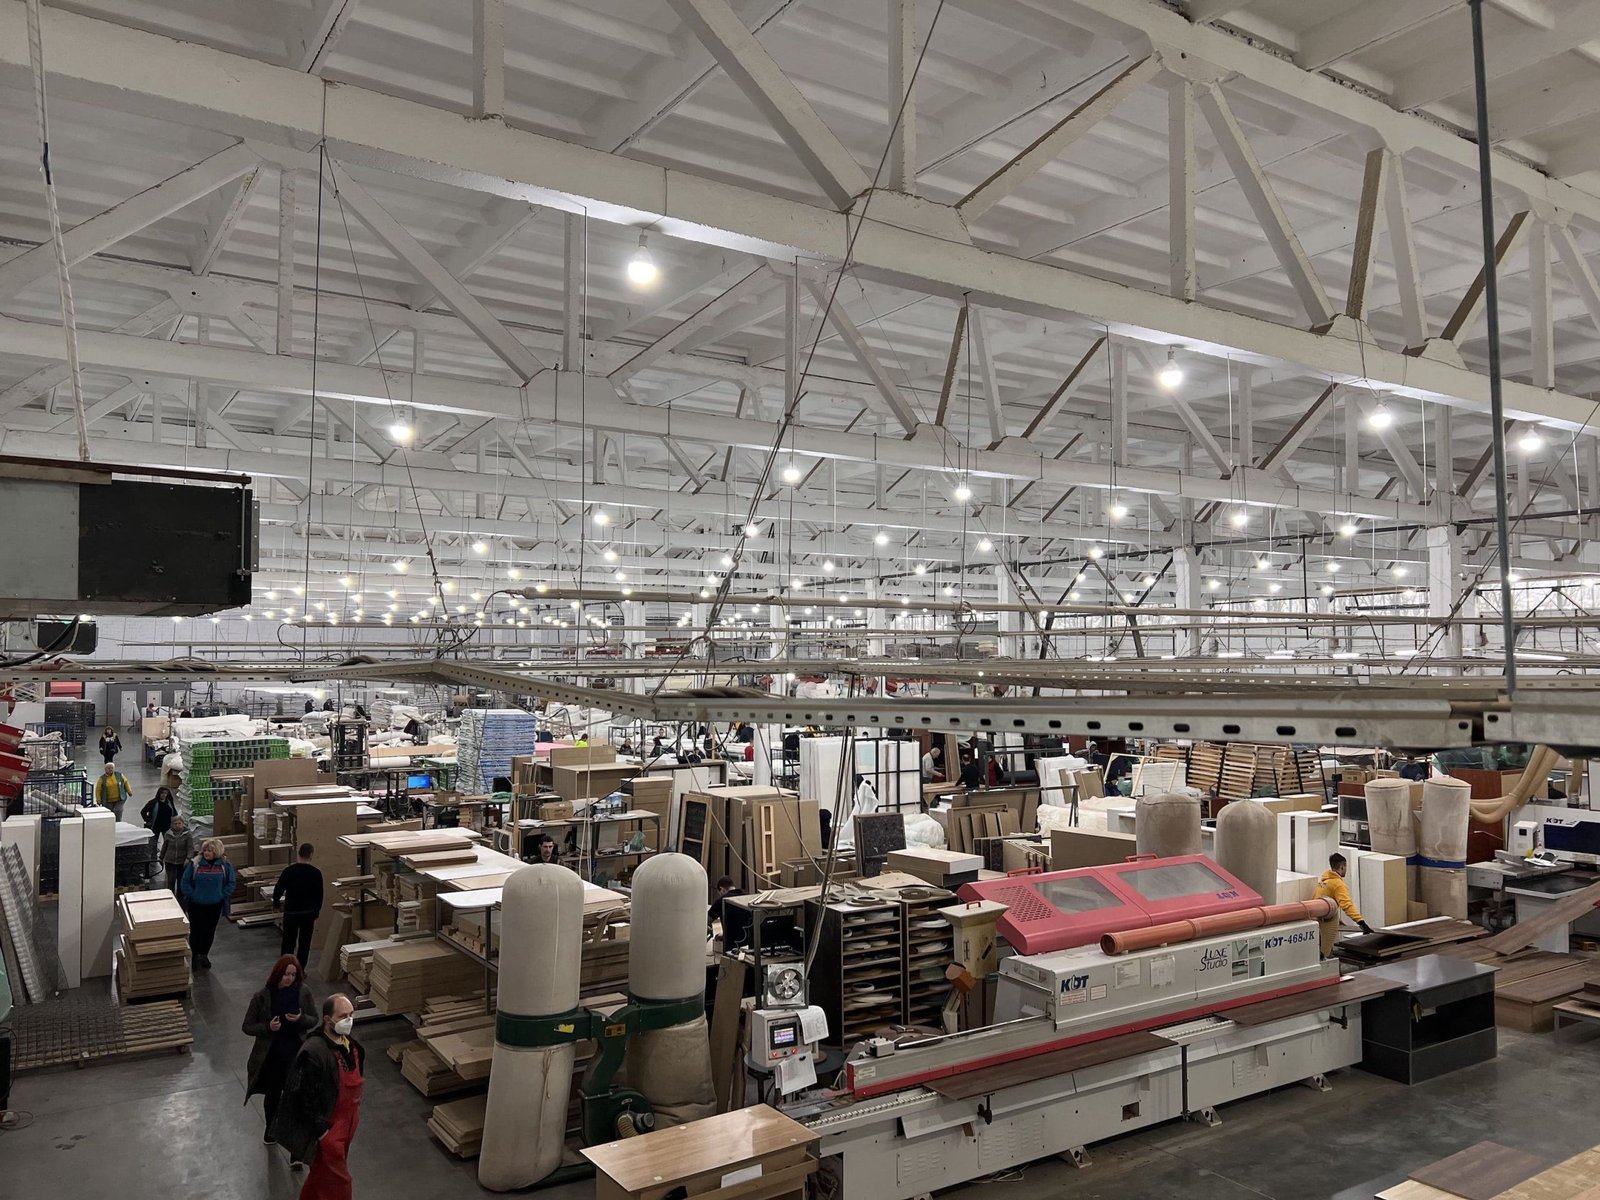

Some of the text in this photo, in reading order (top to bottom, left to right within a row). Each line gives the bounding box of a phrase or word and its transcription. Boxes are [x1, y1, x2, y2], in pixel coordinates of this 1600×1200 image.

[1265, 931, 1315, 949] KDT-468JK
[1200, 957, 1228, 972] Studio
[1060, 974, 1090, 993] KDT
